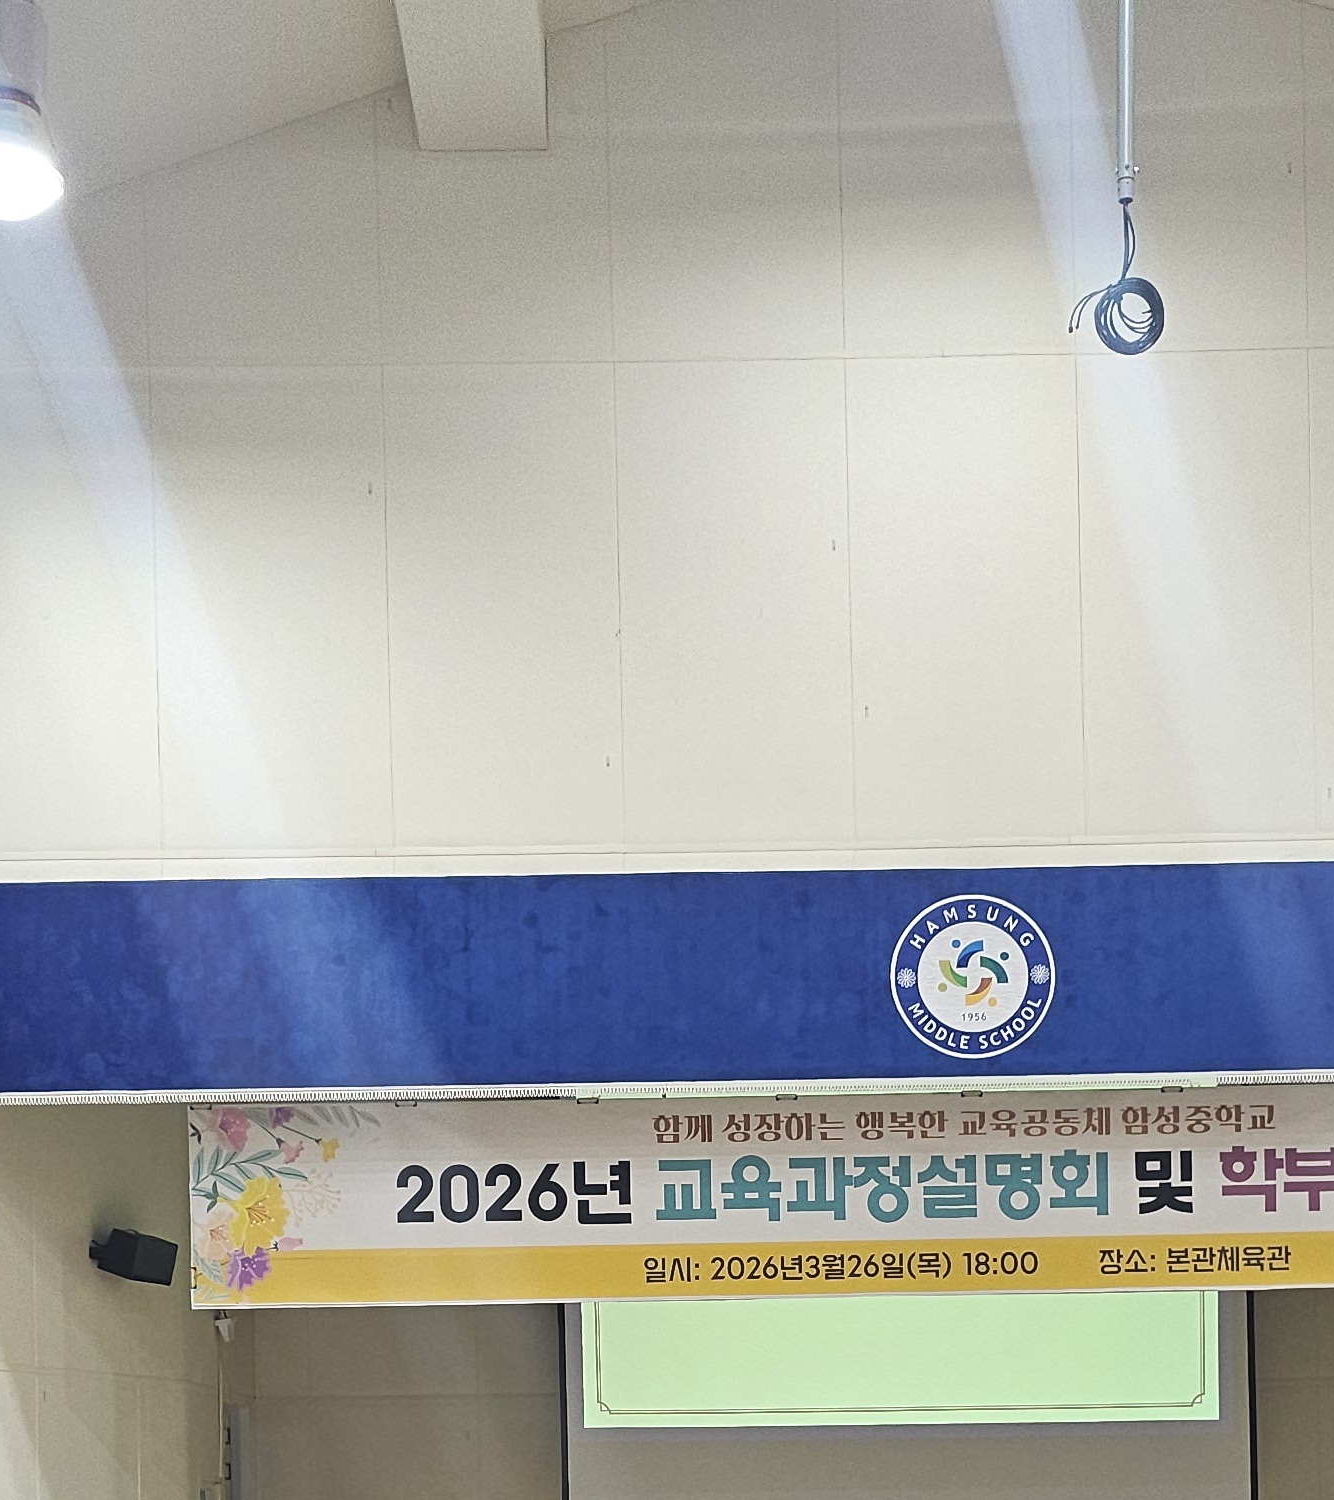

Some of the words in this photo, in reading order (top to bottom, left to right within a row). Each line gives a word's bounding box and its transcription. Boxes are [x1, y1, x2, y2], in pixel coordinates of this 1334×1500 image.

[910, 904, 1035, 949] HAMSUNG
[908, 1002, 971, 1050] MIDDLE
[978, 997, 1043, 1050] SCHOOL
[961, 1012, 987, 1022] 1956
[651, 1113, 713, 1144] 함께
[722, 1112, 846, 1143] 성장하는
[855, 1110, 948, 1140] 행복한
[958, 1106, 1111, 1138] 교육공동체
[1120, 1103, 1276, 1135] 함성중학교
[395, 1159, 632, 1225] 2026년
[655, 1149, 1110, 1223] 교육과정설명회
[1134, 1149, 1195, 1216] 및
[643, 1255, 701, 1284] 일시:
[710, 1251, 953, 1282] 2026년3월26일(목)
[962, 1250, 1039, 1276] 18:00
[1098, 1249, 1157, 1275] 장소:
[1166, 1245, 1292, 1274] 본관체육관
